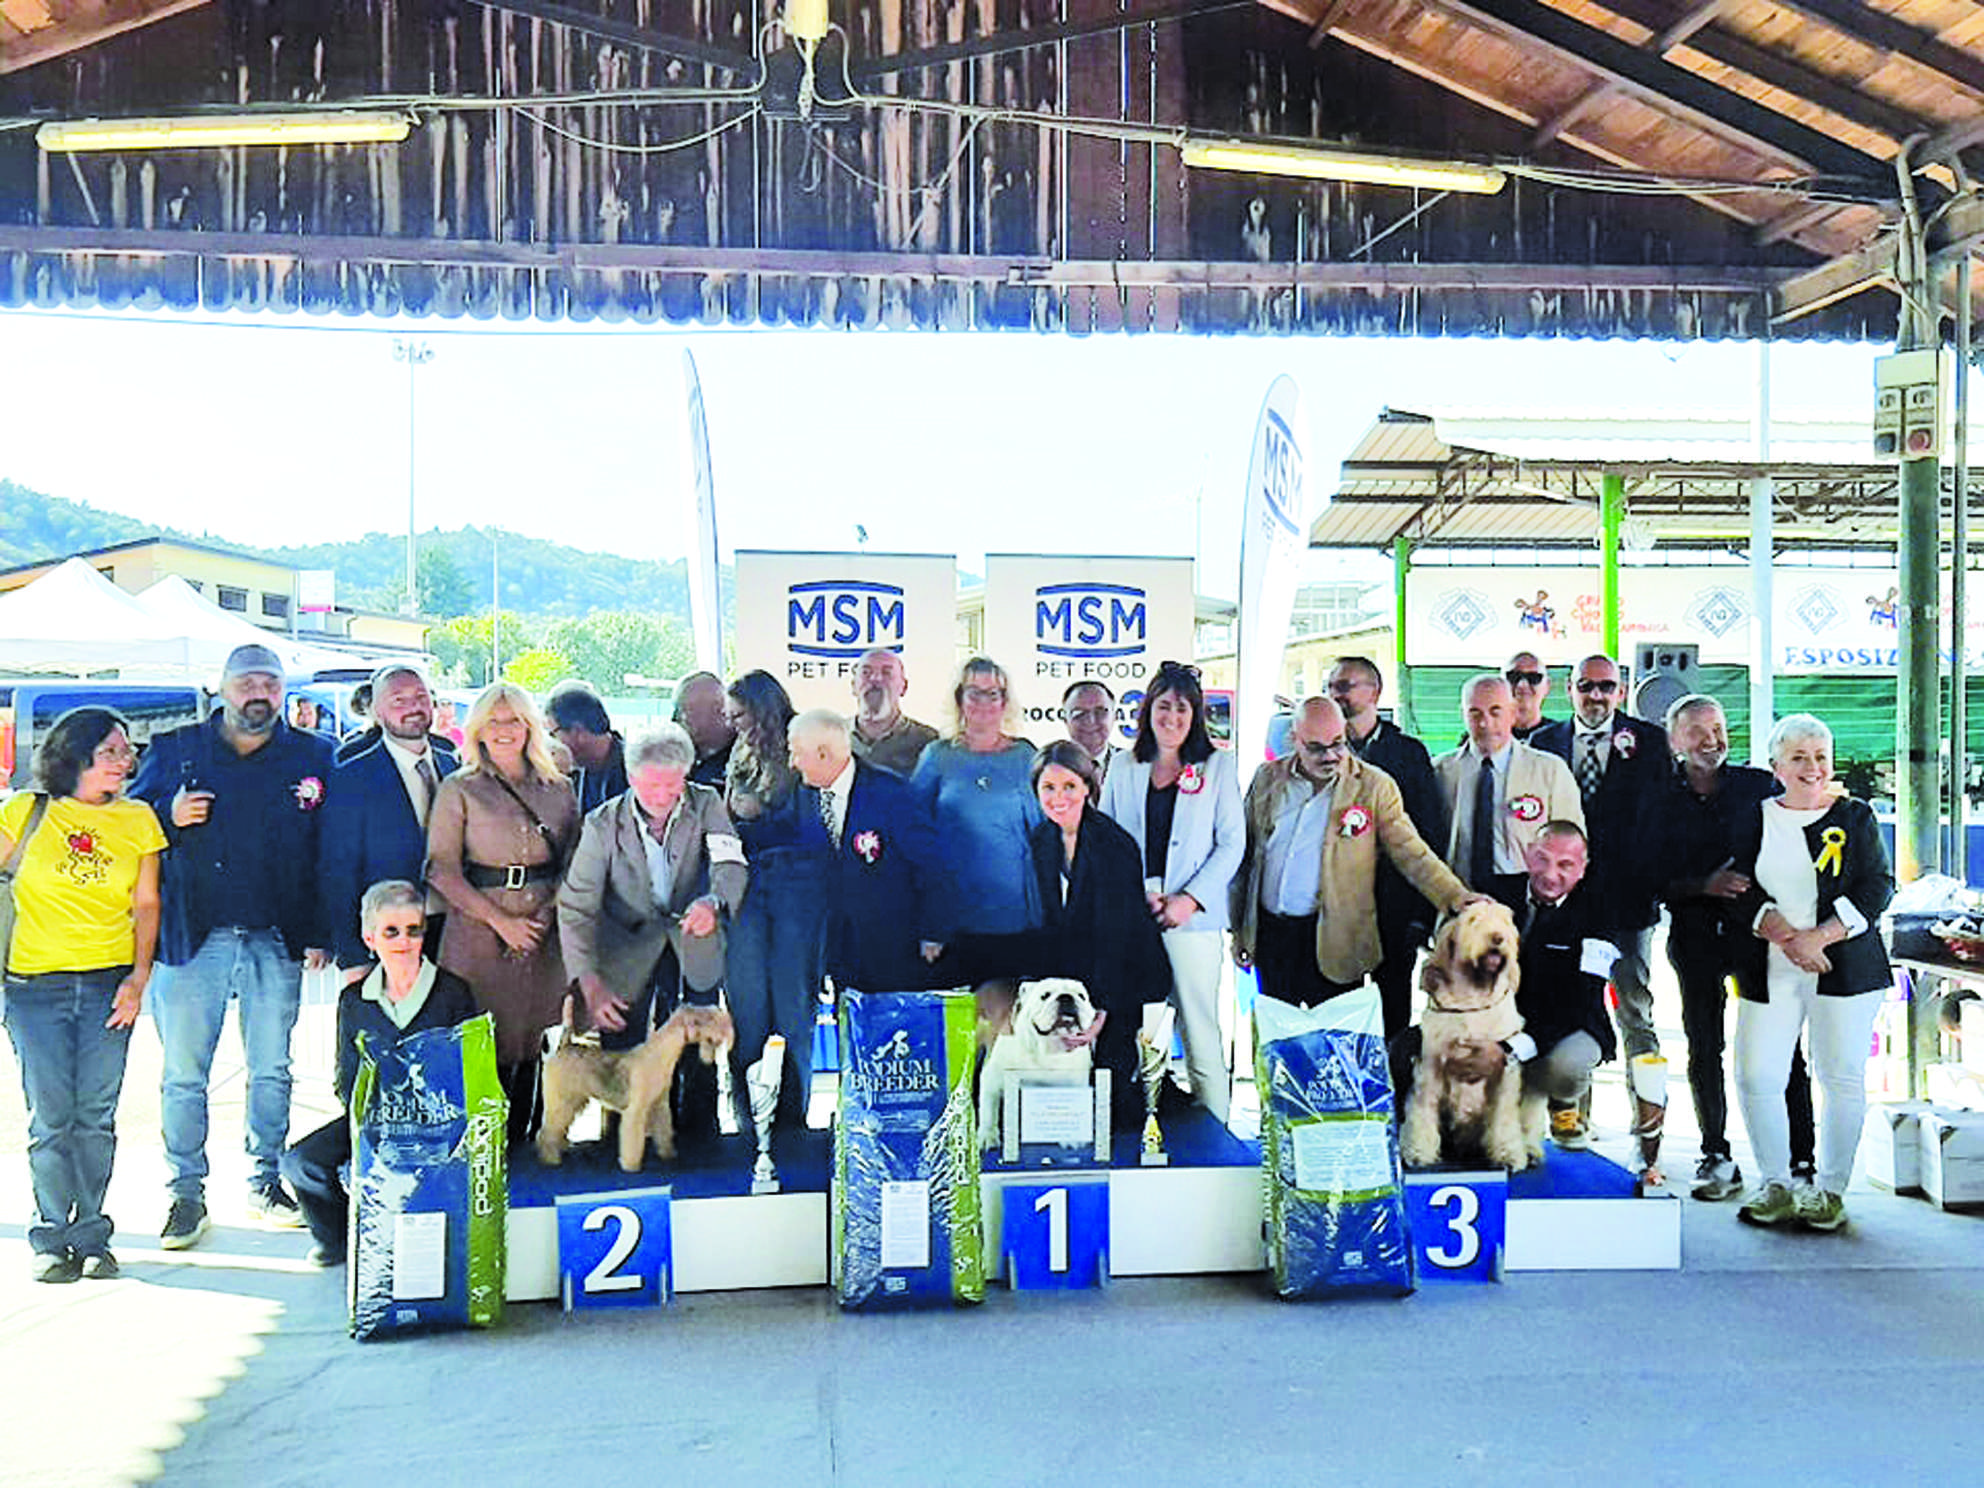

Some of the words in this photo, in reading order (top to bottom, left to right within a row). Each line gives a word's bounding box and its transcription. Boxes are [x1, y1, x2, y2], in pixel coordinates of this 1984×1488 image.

[1264, 426, 1302, 519] MSM
[788, 594, 904, 645] MSM
[1036, 596, 1146, 645] MSM
[788, 662, 829, 678] PET
[1036, 661, 1075, 678] PET
[1084, 662, 1146, 678] FOOD
[582, 1206, 642, 1292] 2
[1035, 1188, 1067, 1271] 1
[1426, 1185, 1479, 1267] 3
